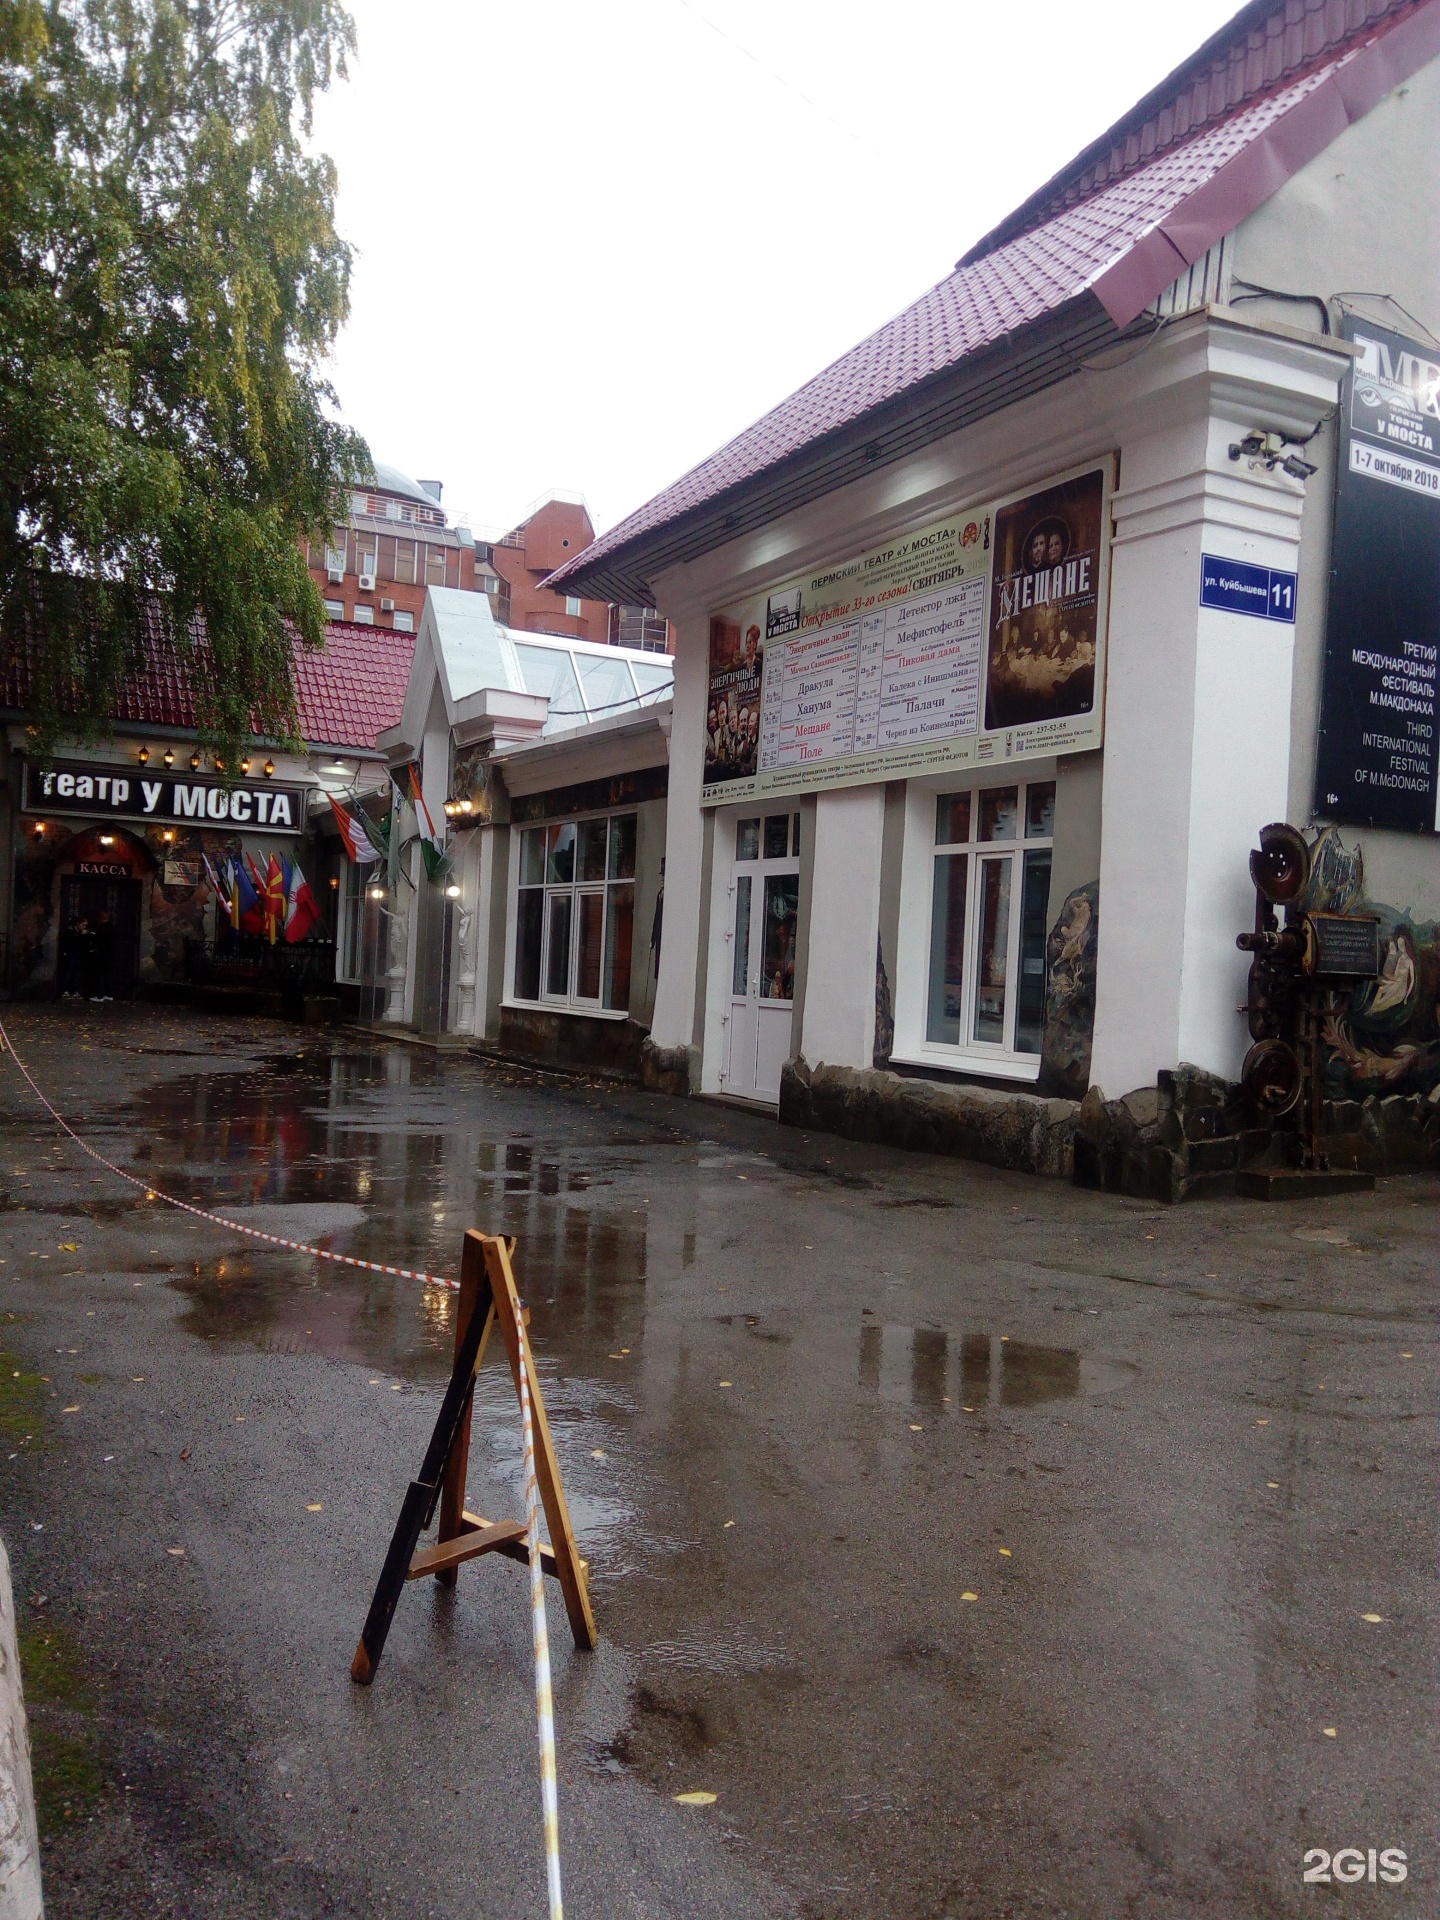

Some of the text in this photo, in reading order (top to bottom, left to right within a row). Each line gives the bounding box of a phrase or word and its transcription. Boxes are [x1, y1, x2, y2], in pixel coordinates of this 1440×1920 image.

[1356, 367, 1377, 381] Martin
[1389, 405, 1424, 422] ПЕРМСКИЙ
[1387, 423, 1433, 450] МОСТА
[1355, 450, 1438, 490] 1-7 октября 2018
[811, 563, 861, 589] ПЕРМСКИЙ
[864, 550, 894, 570] ТЕАТР
[911, 528, 956, 550] МОСТА»
[912, 565, 964, 591] СЕНТЯБРЬ
[994, 557, 1091, 630] МЕЩАНЕ
[1205, 576, 1292, 609] ул. Куйбышева 11
[801, 603, 850, 629] Открытие
[852, 594, 875, 612] 33-го
[898, 599, 942, 622] Детектор
[944, 592, 967, 606] лжи
[773, 619, 798, 635] МОСТА
[897, 617, 965, 644] Мефистофель
[789, 637, 830, 656] Энергичные
[831, 630, 850, 643] люди
[1403, 641, 1437, 661] ТРЕТИЙ
[898, 651, 935, 668] Пиковая
[937, 645, 960, 659] дама
[1352, 649, 1436, 679] МЕЖДУНАРОДНЫЙ
[711, 666, 756, 690] ЭНЕРГИЧНЫЕ
[735, 677, 760, 694] ЛЮДИ
[797, 678, 834, 696] Дракула
[888, 681, 916, 693] Калека
[923, 670, 968, 685] Инишмана
[1382, 675, 1435, 697] ФЕСТИВАЛЬ
[796, 699, 832, 716] Ханума
[906, 698, 945, 714] Палачи
[1369, 690, 1434, 716] М.МАКДОНАХА
[795, 721, 831, 737] Мещане
[885, 729, 907, 740] Череп
[909, 726, 918, 735] из
[920, 718, 966, 733] Коннемары
[1016, 722, 1067, 737] Касса: 237-52-55
[1406, 721, 1433, 739] THIRD
[800, 746, 823, 760] Поле
[1363, 732, 1431, 757] INTERNATIONAL
[1390, 755, 1430, 775] FESTIVAL
[1354, 769, 1430, 793] OF M.McDONAGH
[173, 784, 292, 826] МОСТА
[1326, 793, 1339, 804] 16+
[80, 863, 127, 876] КАССА
